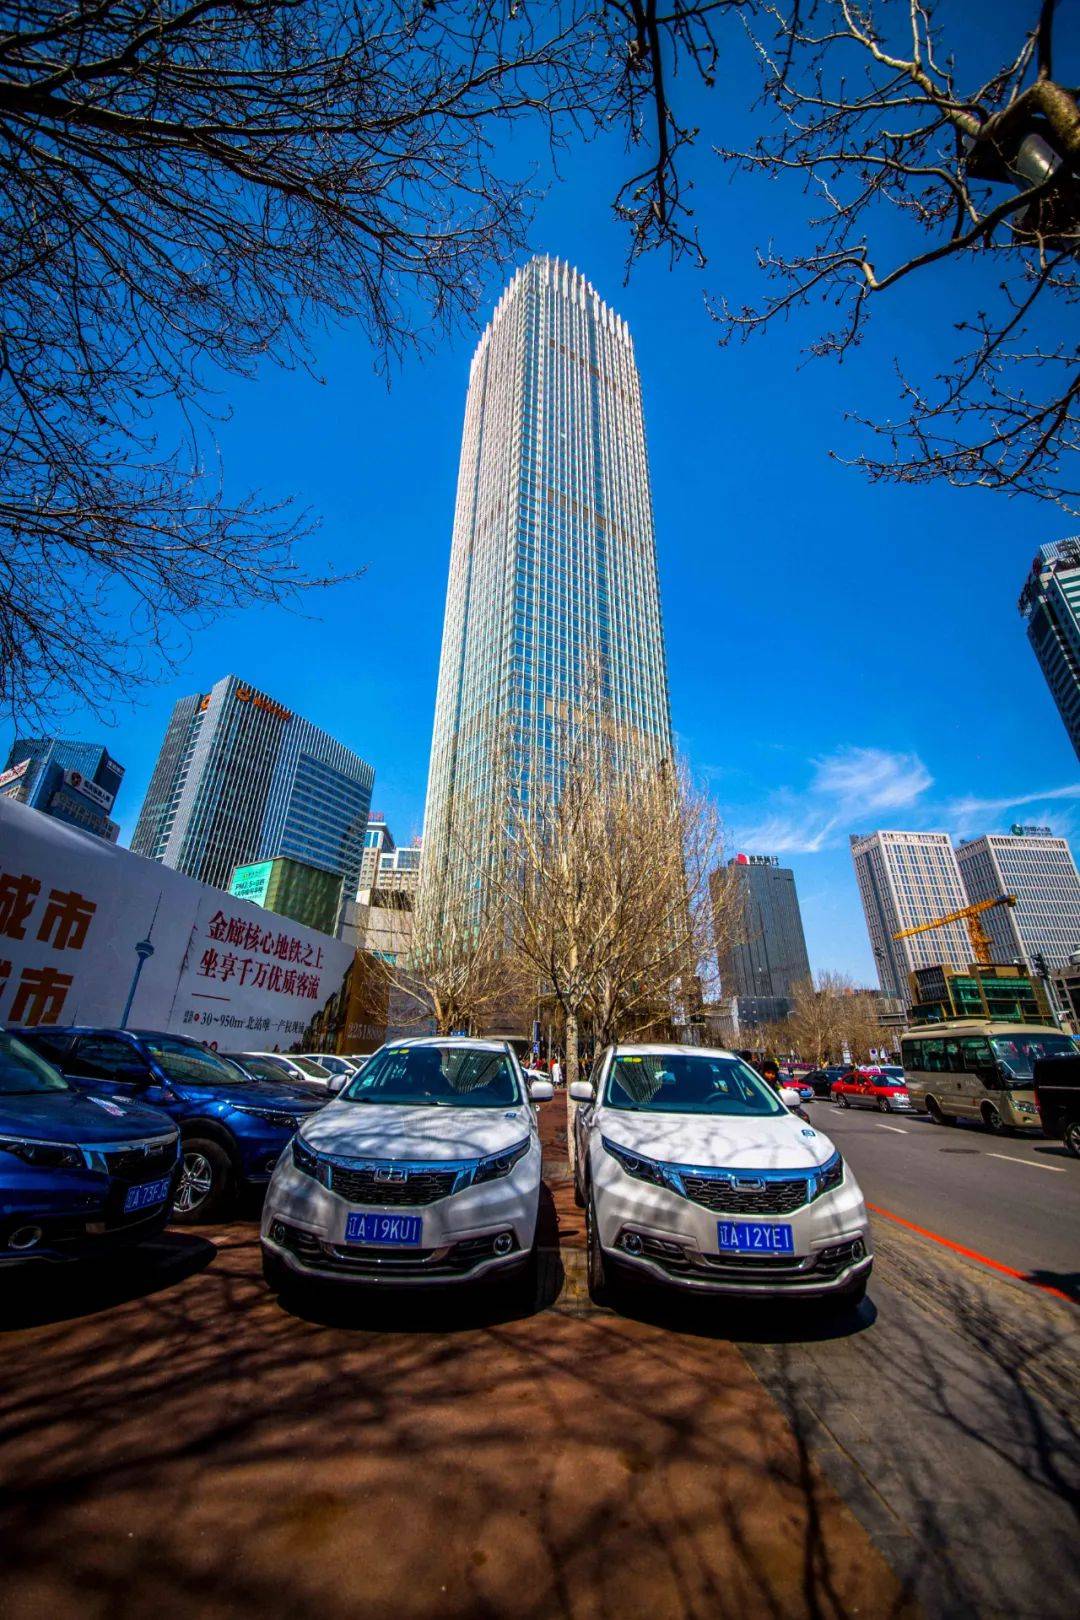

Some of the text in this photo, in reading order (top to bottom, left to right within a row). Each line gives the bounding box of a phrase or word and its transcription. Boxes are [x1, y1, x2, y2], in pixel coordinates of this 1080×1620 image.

[206, 910, 325, 969] 金廊核心地铁之上
[0, 959, 74, 1026] 市
[197, 948, 321, 1000] 坐享千万优质客流
[720, 1225, 790, 1248] 辽A·12YE1
